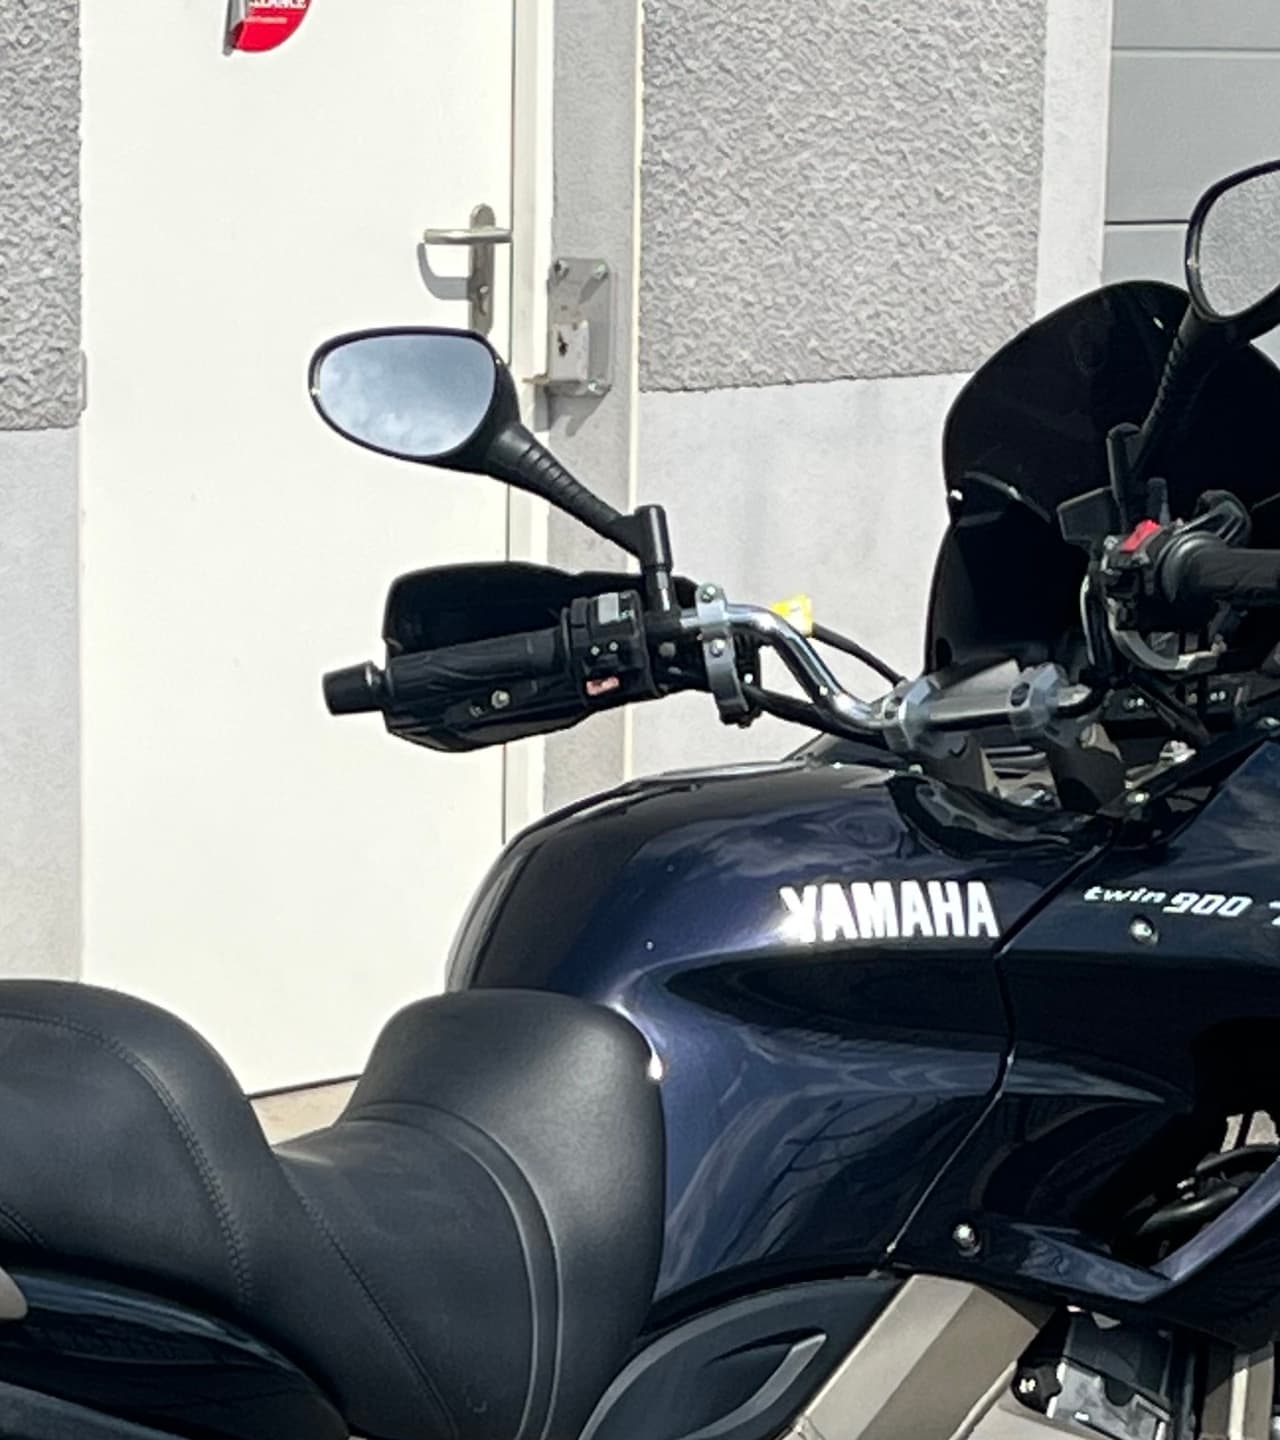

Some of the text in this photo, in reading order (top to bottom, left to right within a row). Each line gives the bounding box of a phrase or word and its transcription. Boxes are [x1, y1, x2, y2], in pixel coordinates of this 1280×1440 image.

[778, 879, 1000, 942] YAMAHA
[1084, 884, 1165, 905] twin
[1164, 892, 1251, 917] 900
